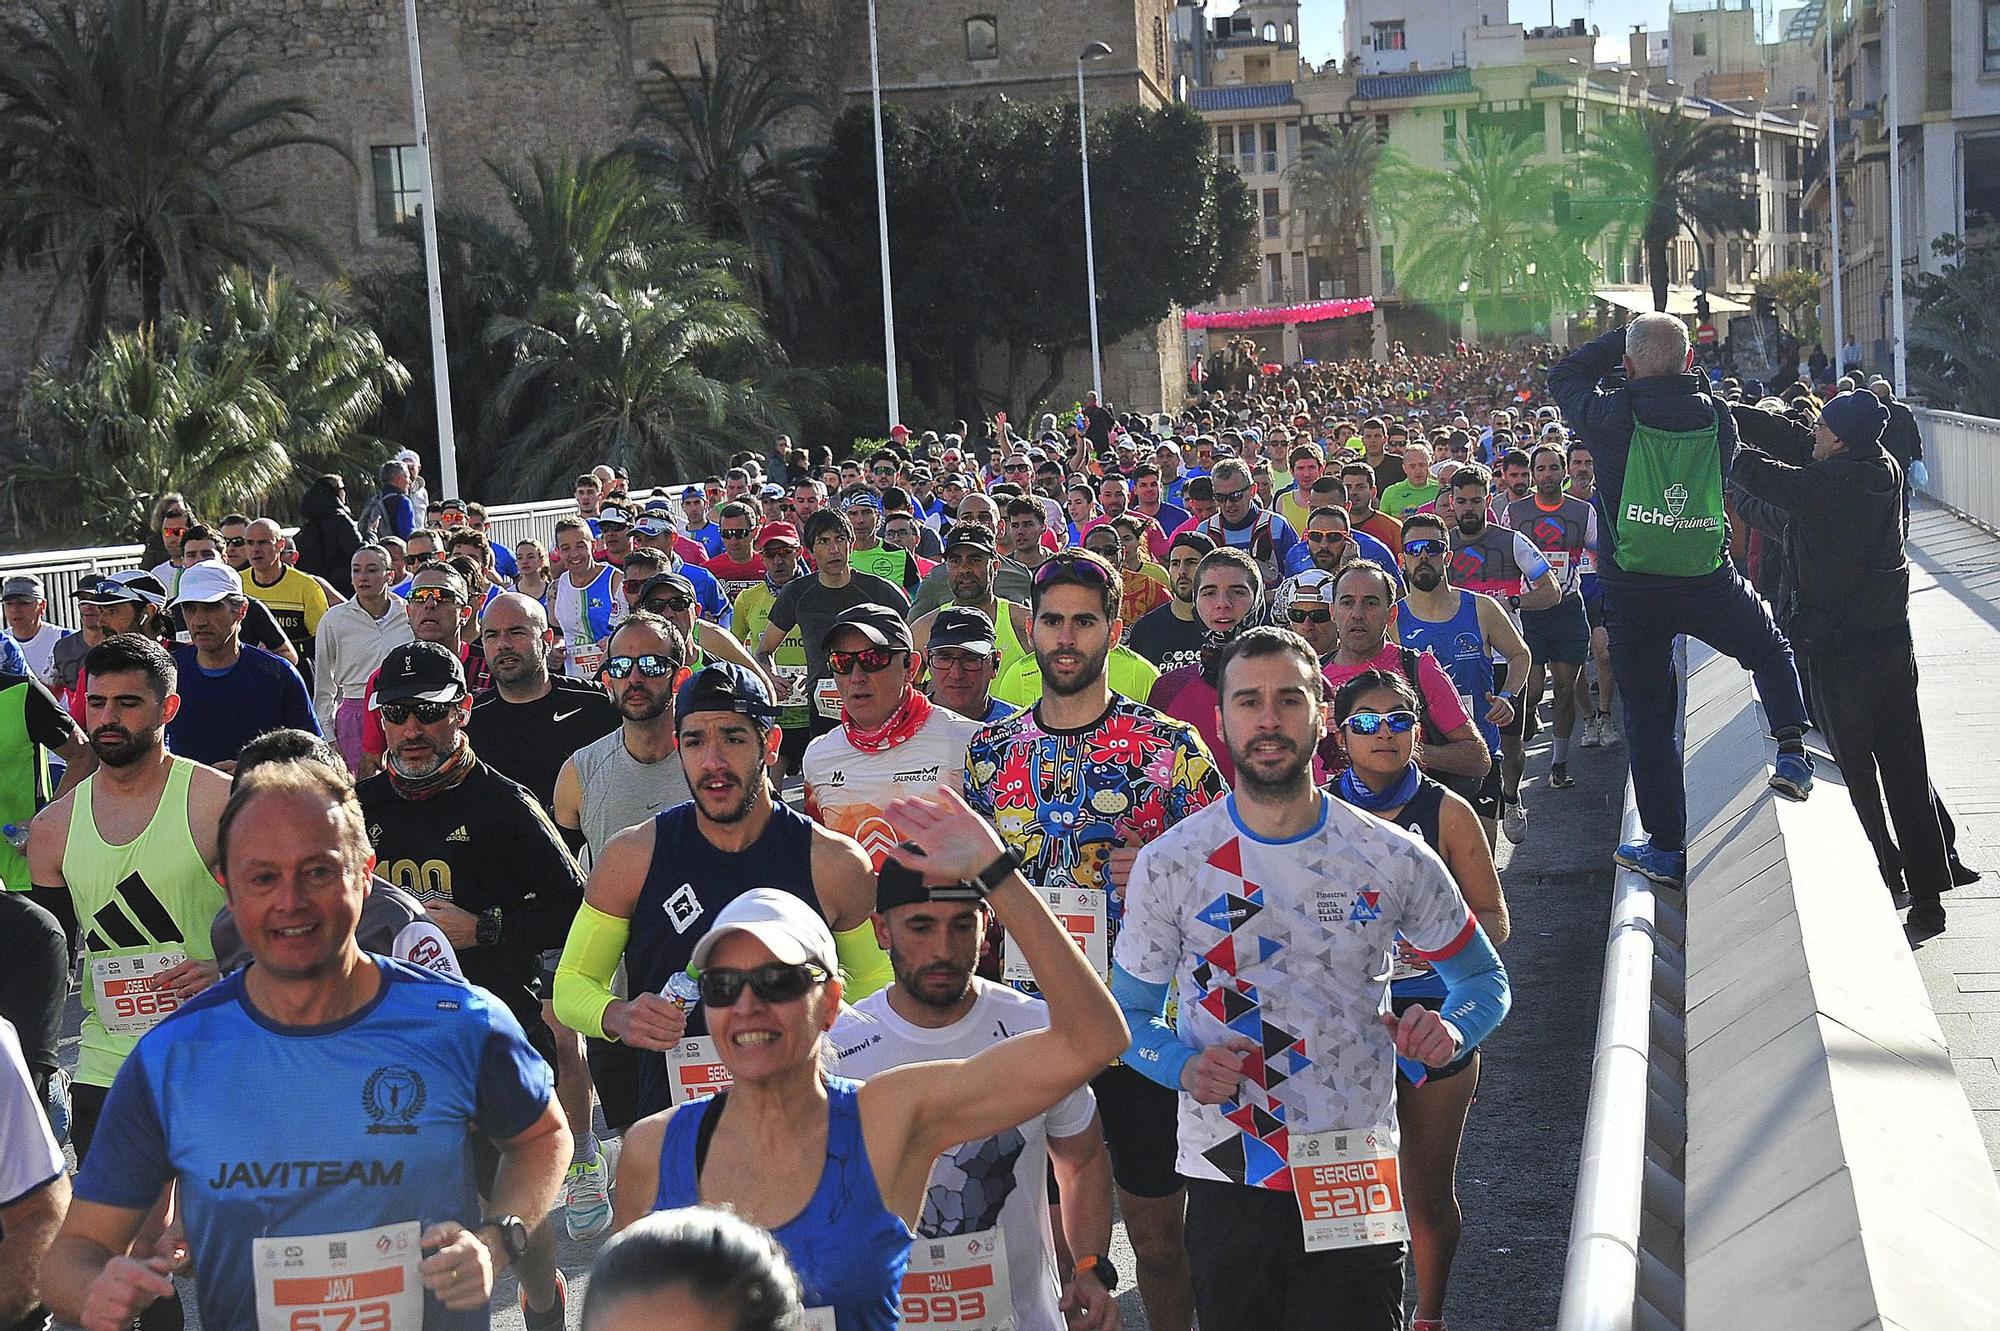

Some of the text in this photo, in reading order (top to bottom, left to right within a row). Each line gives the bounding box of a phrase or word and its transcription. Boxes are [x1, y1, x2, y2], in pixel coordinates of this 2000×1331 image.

[1626, 504, 1674, 527] Elche
[922, 774, 938, 782] CAR
[446, 834, 471, 842] adidas
[123, 980, 144, 994] JOSE
[115, 992, 179, 1018] 965
[209, 1159, 405, 1191] JAVITEAM
[1313, 1162, 1378, 1186] SERGIO
[1309, 1183, 1393, 1219] 5210
[323, 1277, 354, 1303] JAVI
[928, 1274, 952, 1292] PAU
[902, 1291, 987, 1324] 993
